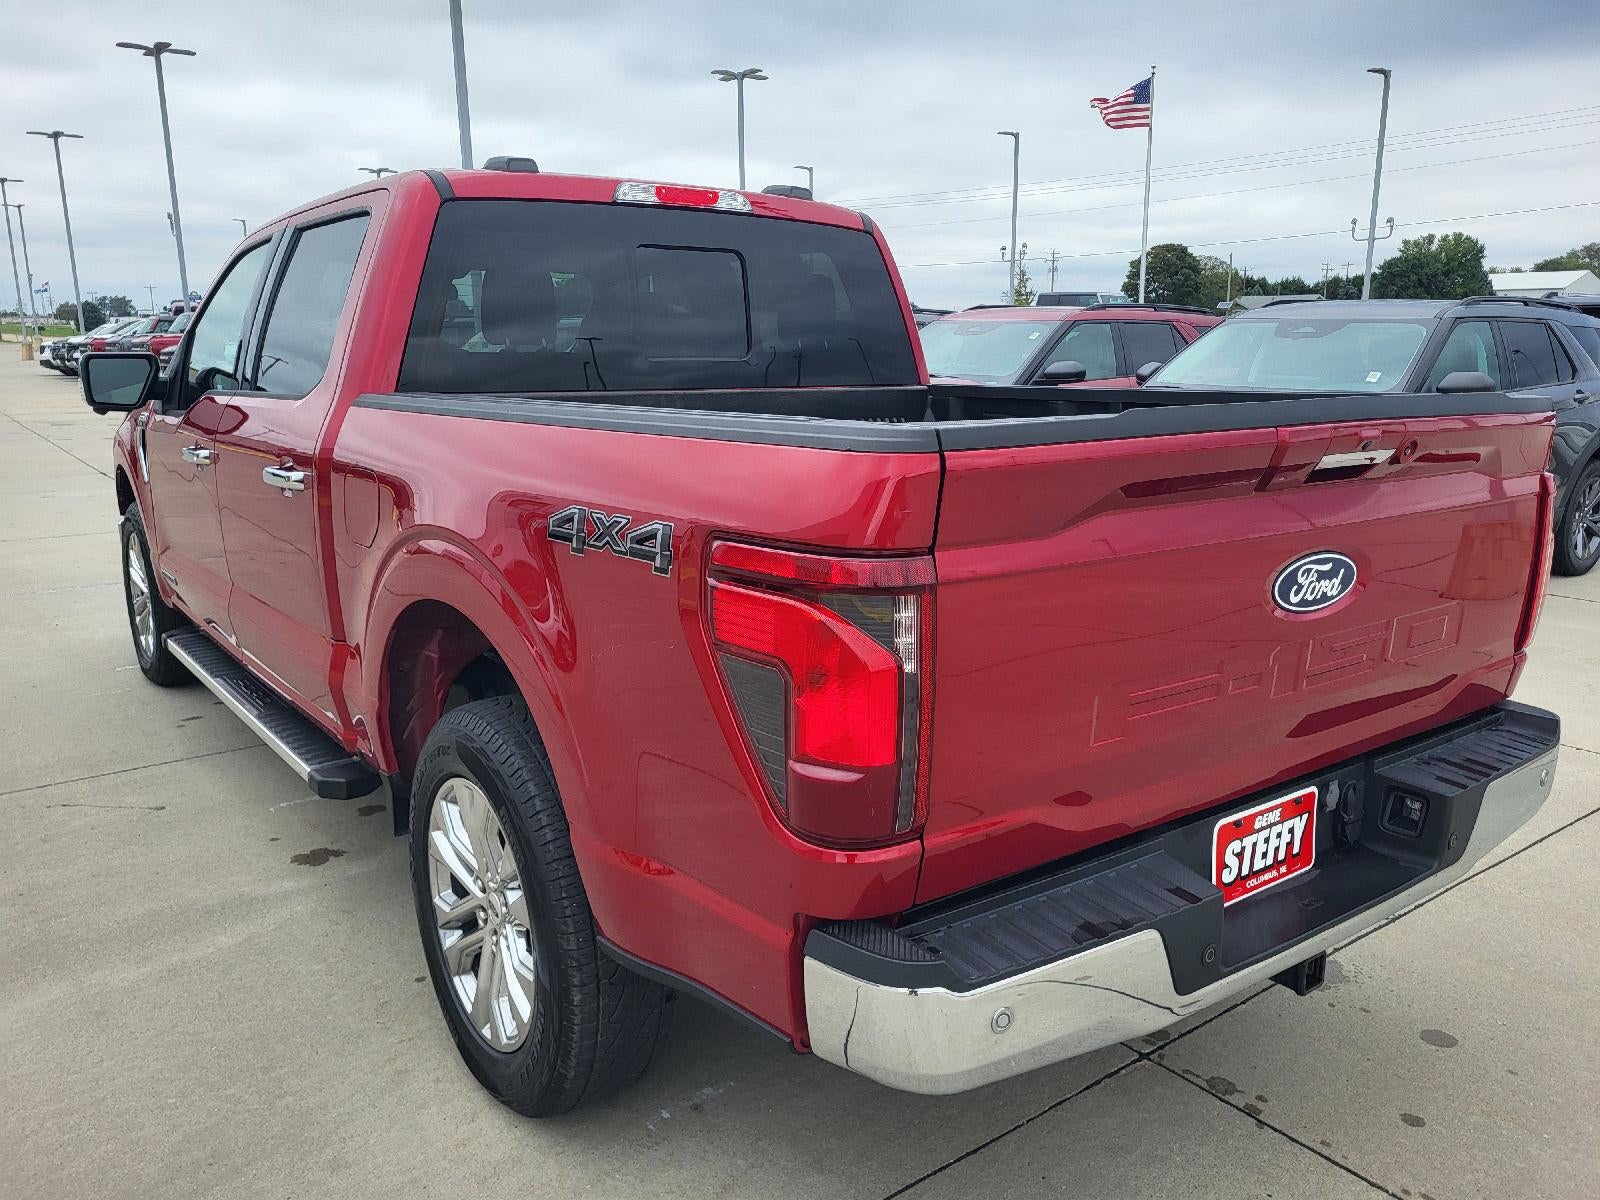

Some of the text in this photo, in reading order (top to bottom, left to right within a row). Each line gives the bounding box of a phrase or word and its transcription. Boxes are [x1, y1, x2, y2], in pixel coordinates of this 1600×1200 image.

[1289, 562, 1344, 604] Ford
[1091, 602, 1464, 746] F-150
[1254, 808, 1282, 830] GENE
[1221, 812, 1311, 886] STEFFY
